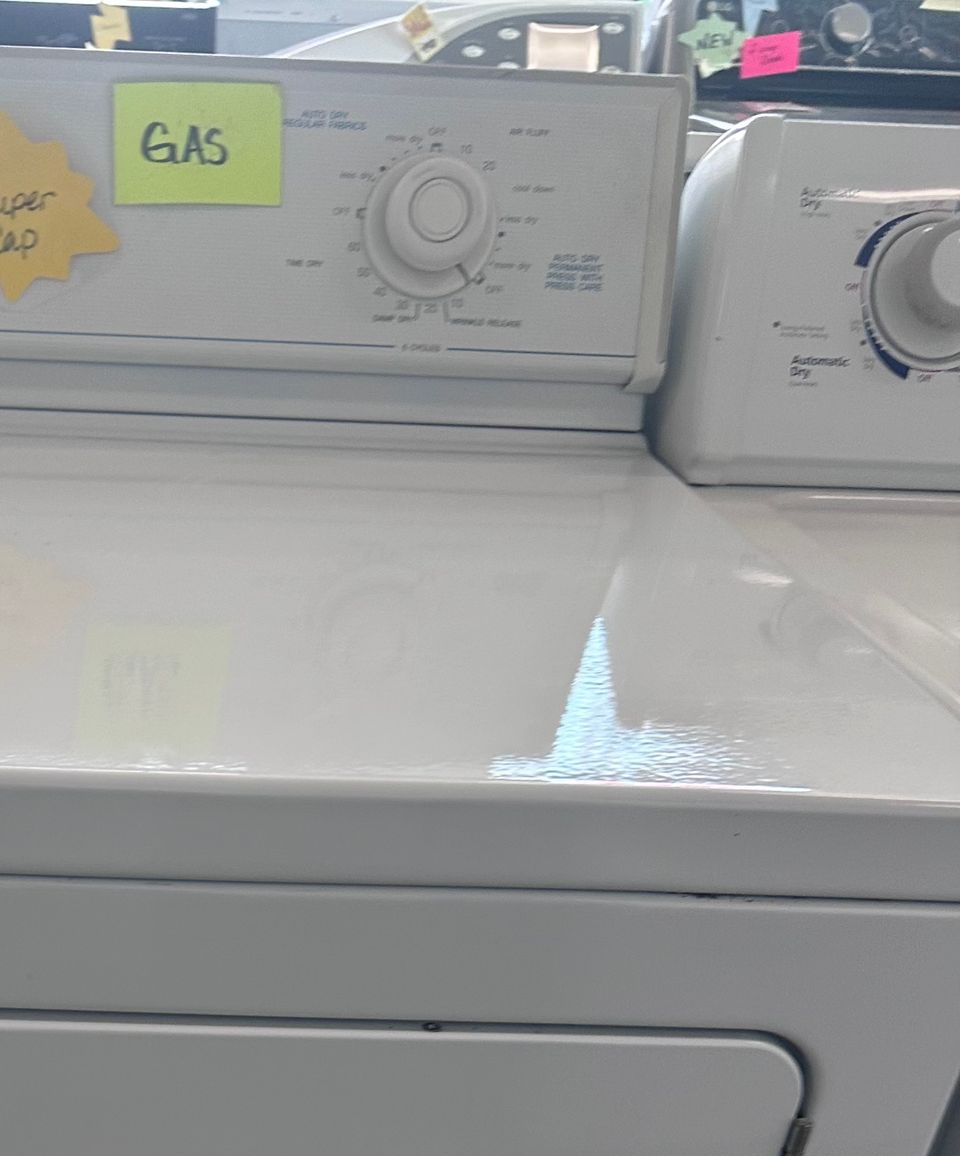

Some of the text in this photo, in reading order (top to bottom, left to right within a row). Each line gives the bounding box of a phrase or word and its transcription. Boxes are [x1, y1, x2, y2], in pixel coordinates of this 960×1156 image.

[697, 30, 735, 50] NEW
[141, 121, 229, 166] GAS
[800, 198, 822, 211] Dry
[791, 355, 851, 368] Automatic
[790, 367, 811, 379] Dry
